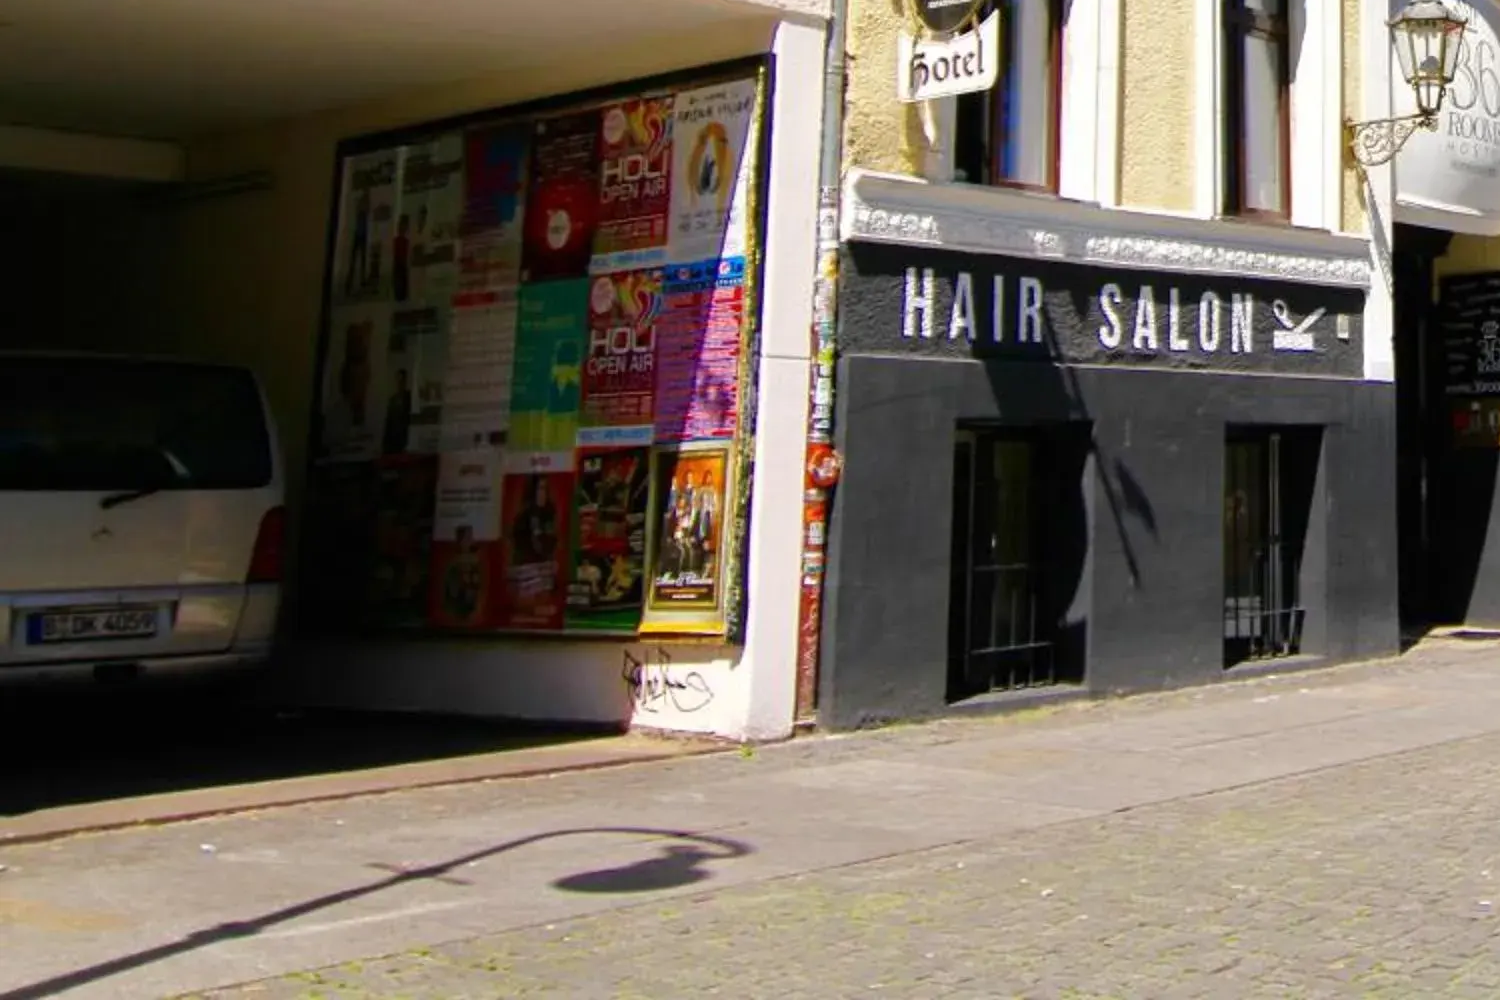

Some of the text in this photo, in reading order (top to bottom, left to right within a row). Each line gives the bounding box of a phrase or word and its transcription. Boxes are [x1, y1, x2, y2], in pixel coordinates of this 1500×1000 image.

[602, 148, 669, 184] HOLI
[901, 266, 1043, 343] HAIR
[1100, 282, 1255, 354] SALON
[590, 325, 655, 356] HOLI
[587, 354, 654, 376] OPEN AIR
